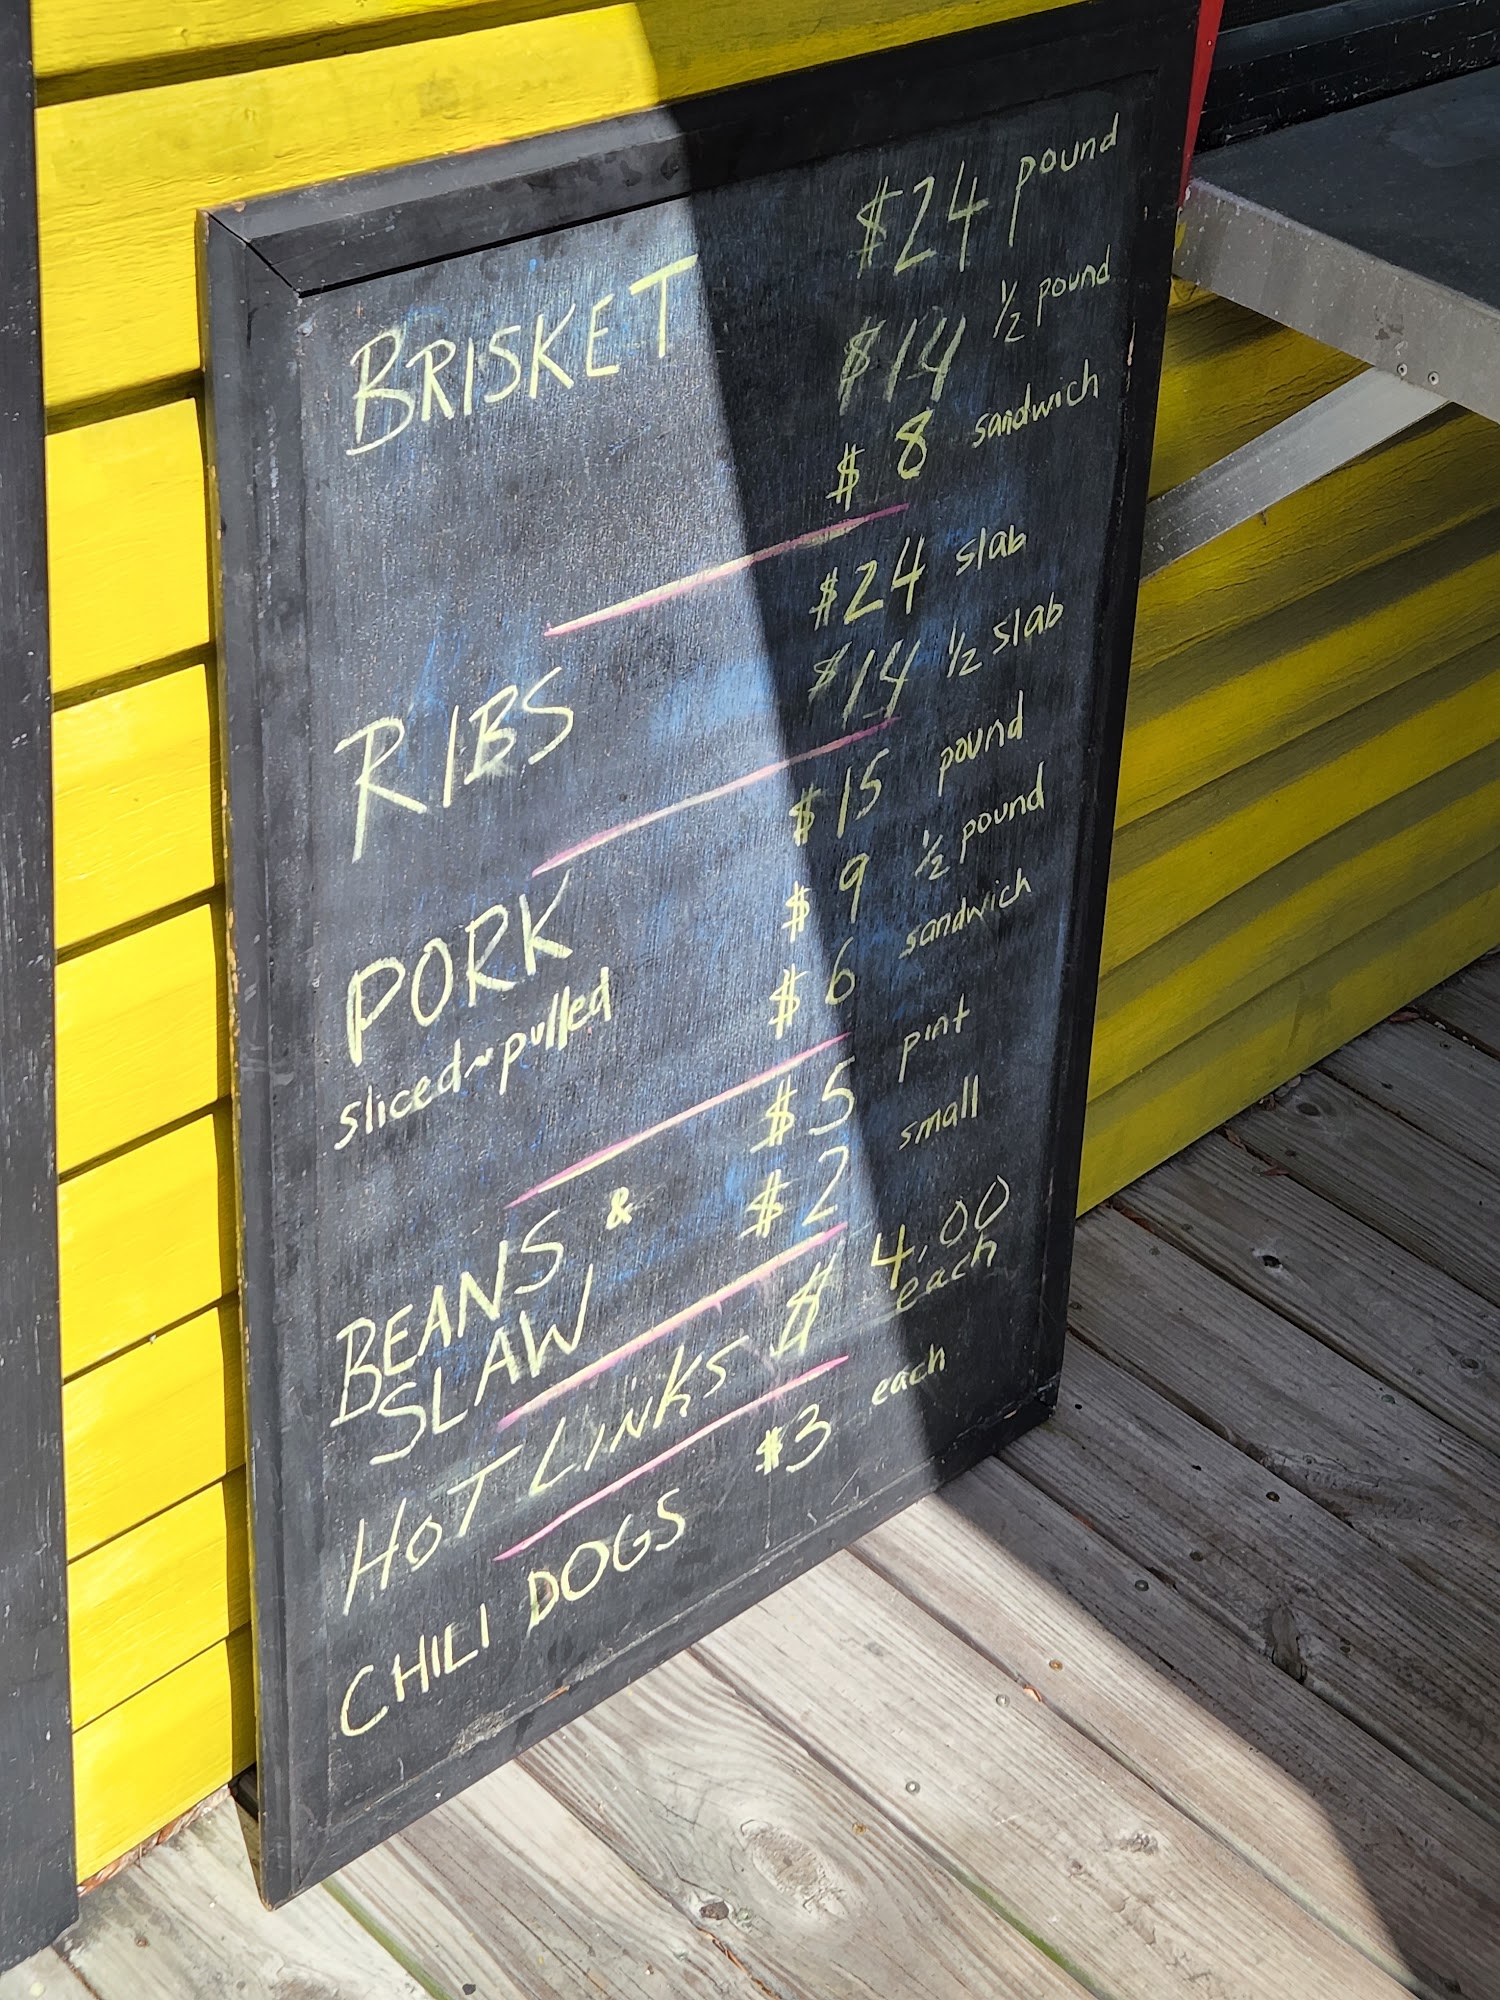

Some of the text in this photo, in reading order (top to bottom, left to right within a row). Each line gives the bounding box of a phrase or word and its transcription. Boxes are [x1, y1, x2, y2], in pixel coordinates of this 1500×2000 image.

[853, 112, 1119, 278] $24 pound
[346, 253, 699, 456] BRISKET
[837, 308, 966, 416] $14
[1036, 244, 1111, 327] pound
[972, 358, 1099, 449] sandwich
[809, 524, 1027, 631] $24 slab
[807, 640, 922, 730] $14
[992, 592, 1065, 656] slab
[333, 666, 574, 864] RIBS
[789, 690, 1024, 846] $15 pound
[959, 761, 1045, 865] pound
[346, 868, 574, 1068] PORK
[898, 867, 1031, 960] sandwich
[898, 993, 971, 1083] pint
[899, 1074, 980, 1150] small
[330, 1185, 635, 1428] BEANS &
[894, 1231, 998, 1314] each
[369, 1263, 594, 1465] SLAW
[754, 1343, 947, 1475] $3 each
[340, 1488, 687, 1737] CHILI DOGS
